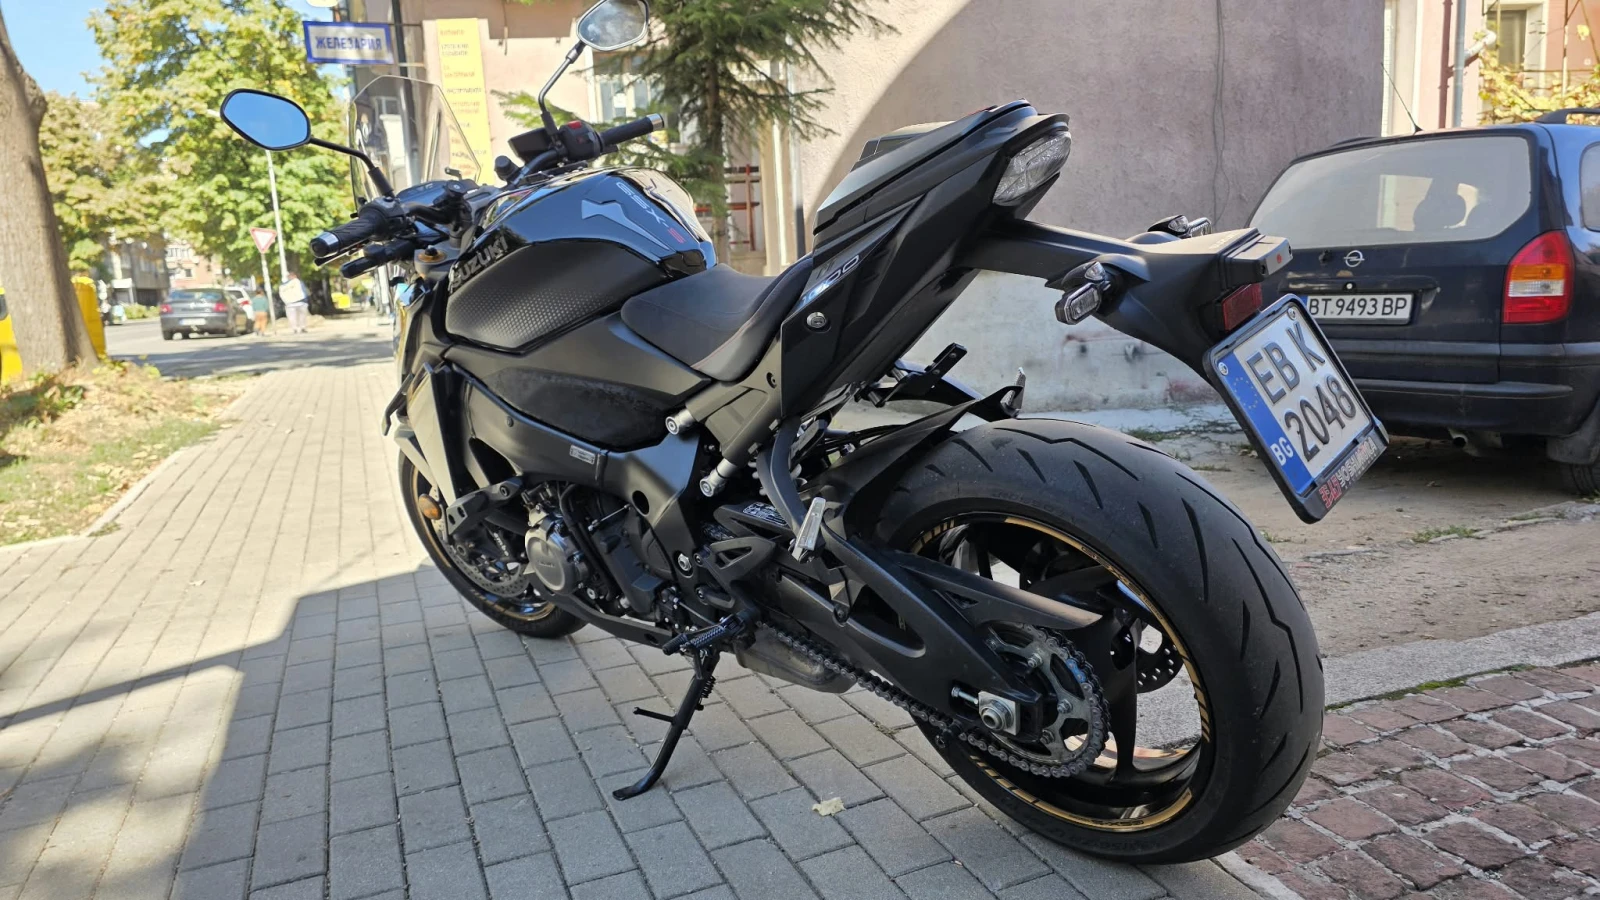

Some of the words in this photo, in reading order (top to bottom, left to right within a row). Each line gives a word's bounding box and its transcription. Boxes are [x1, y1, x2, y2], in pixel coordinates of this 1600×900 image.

[315, 36, 382, 50] ЖЕЛЕЗАРИЯ
[615, 181, 686, 244] GSX-S
[448, 235, 509, 294] SUZUKI
[1335, 298, 1378, 316] 9493
[1284, 375, 1357, 462] 2048
[1269, 436, 1294, 466] BG
